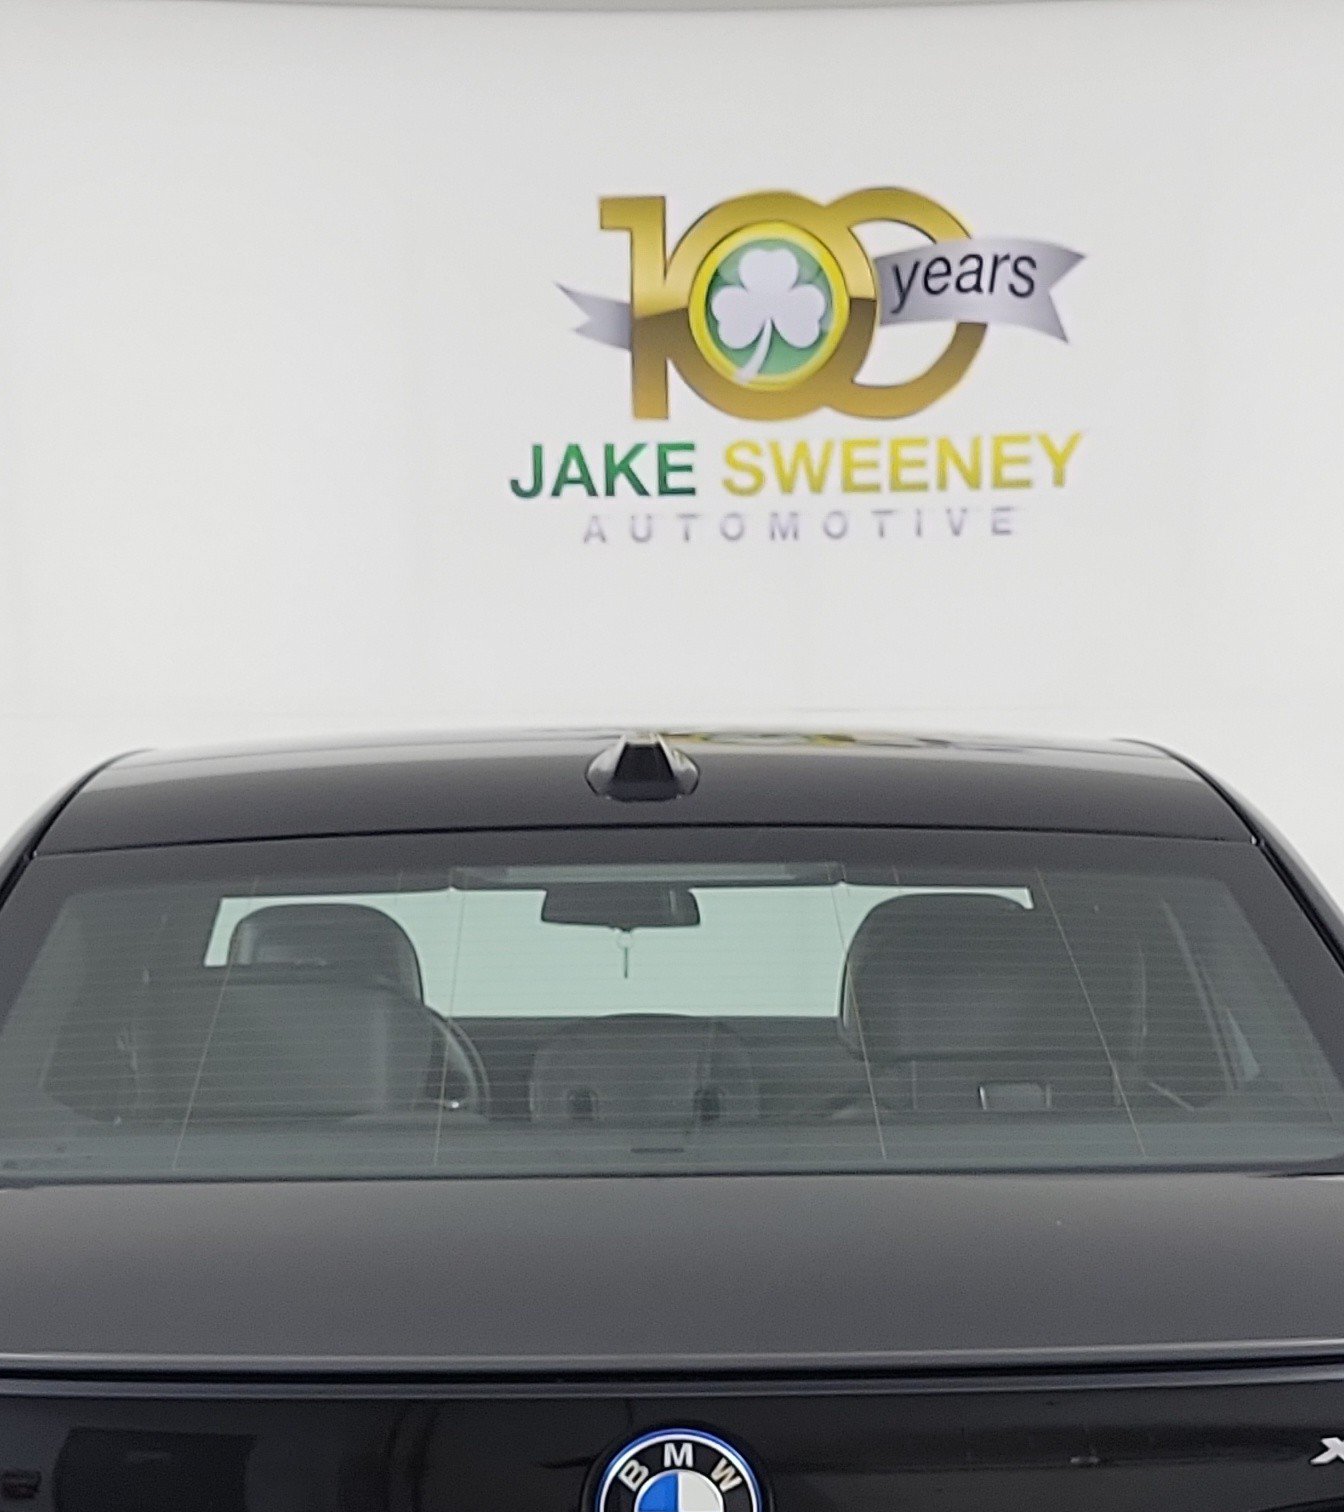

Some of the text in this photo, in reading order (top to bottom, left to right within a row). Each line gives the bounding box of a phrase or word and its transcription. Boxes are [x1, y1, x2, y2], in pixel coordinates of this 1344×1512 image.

[890, 247, 1037, 315] years
[509, 431, 1083, 499] JAKE SWEENEY
[583, 506, 1017, 544] AUTOMOTIVE
[617, 1442, 742, 1492] BMW
